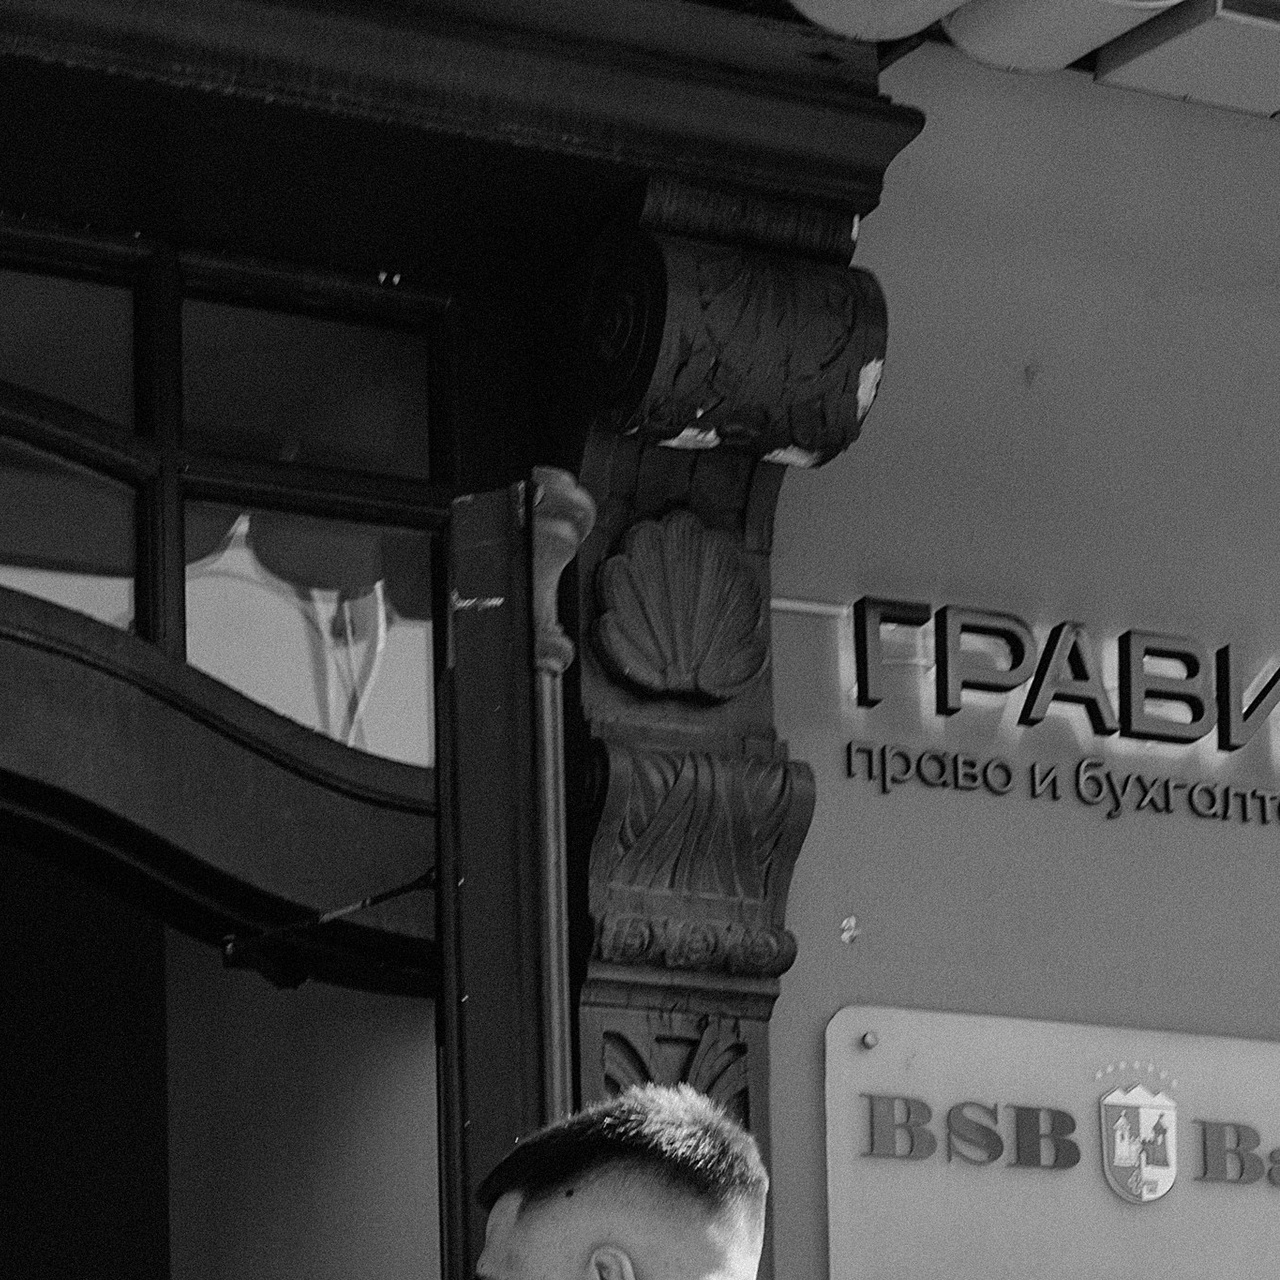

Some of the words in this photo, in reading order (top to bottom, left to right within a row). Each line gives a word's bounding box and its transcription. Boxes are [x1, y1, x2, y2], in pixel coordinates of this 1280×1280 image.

[845, 740, 1014, 794] право
[1030, 762, 1062, 801] и
[1075, 757, 1280, 826] бухгалт
[859, 1093, 1082, 1171] BSB
[1191, 1117, 1280, 1188] B
